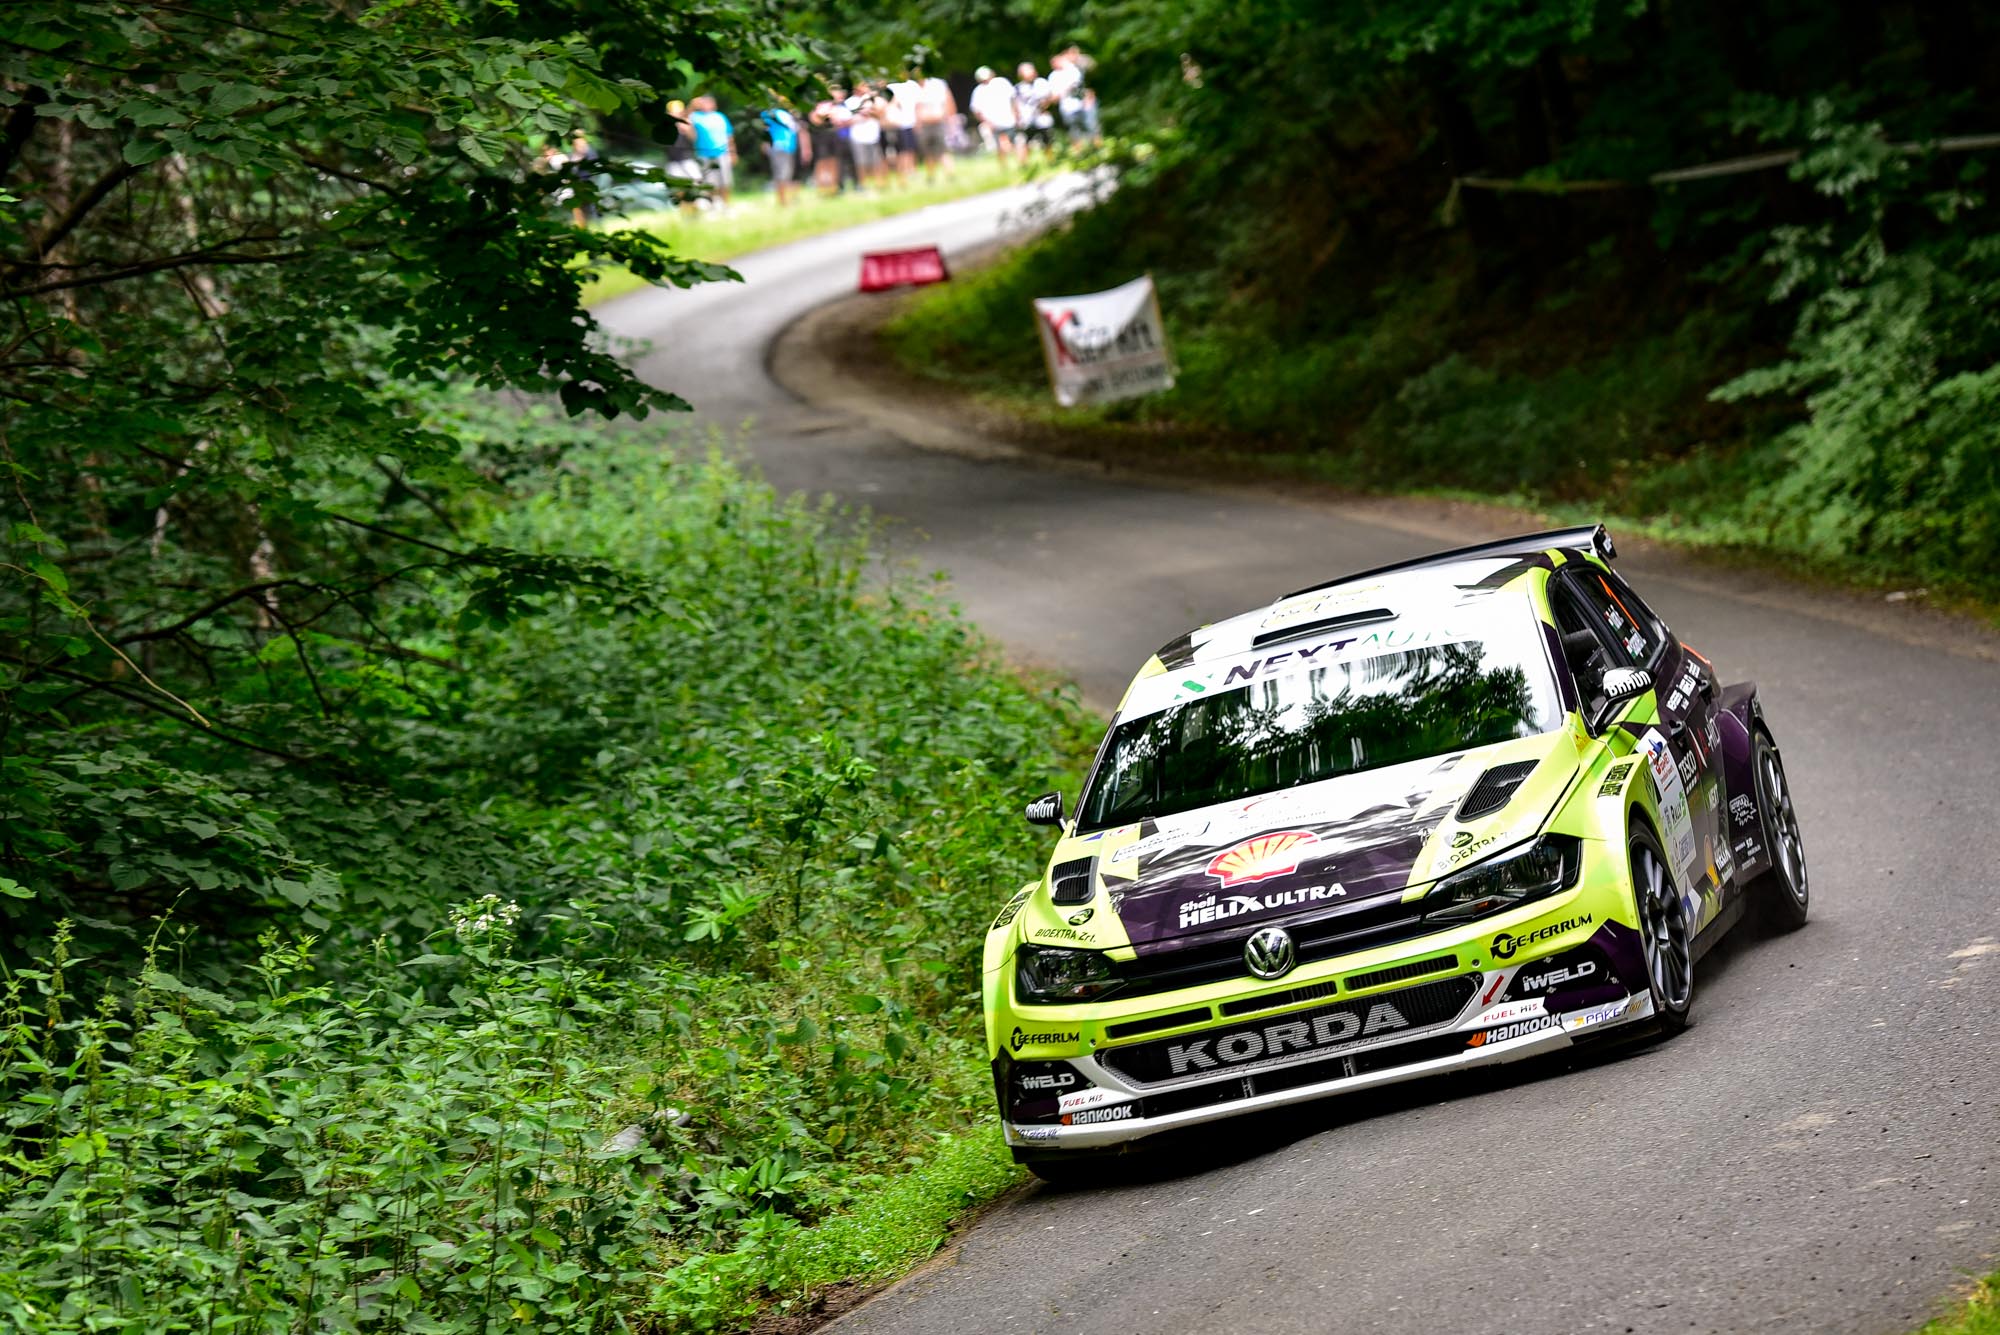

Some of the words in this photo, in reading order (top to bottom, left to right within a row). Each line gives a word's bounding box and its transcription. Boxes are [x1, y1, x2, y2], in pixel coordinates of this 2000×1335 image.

[1178, 896, 1265, 929] HELIX
[1264, 882, 1347, 909] ULTRA
[1179, 895, 1216, 914] Shell
[1035, 928, 1077, 940] BIOEXTRA
[1505, 912, 1593, 951] FE-FERRUM
[1483, 1009, 1516, 1023] FUEL
[1167, 1001, 1410, 1074] KORDA
[1062, 1097, 1086, 1109] FUEL
